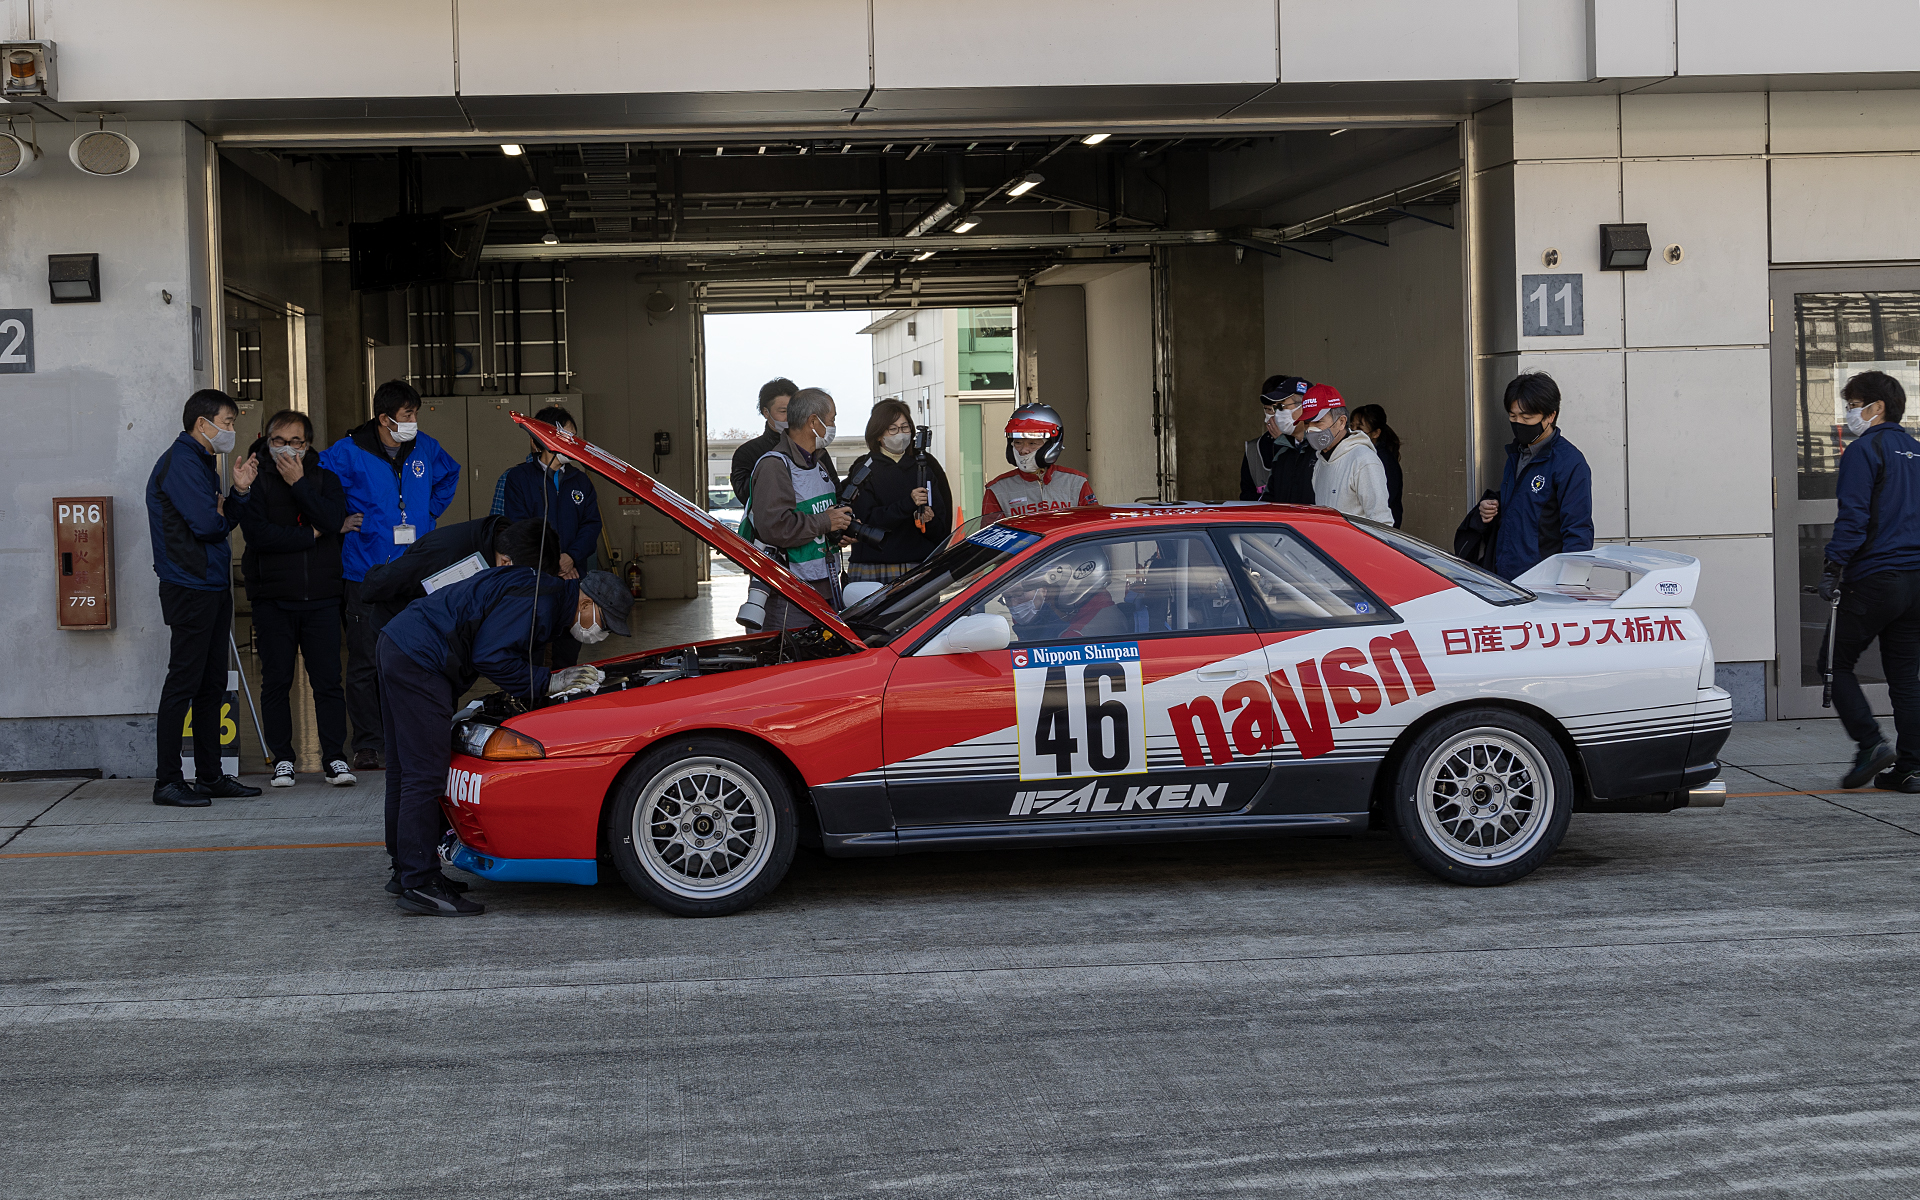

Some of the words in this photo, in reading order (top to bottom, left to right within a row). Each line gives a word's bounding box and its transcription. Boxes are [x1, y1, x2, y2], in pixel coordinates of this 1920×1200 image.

[1529, 281, 1574, 327] 11
[58, 504, 101, 524] PR6
[1010, 500, 1071, 516] NISSAN
[69, 596, 96, 607] 775
[1442, 615, 1686, 656] 日産プリンス栃木
[1033, 648, 1081, 665] Nippon
[1084, 644, 1139, 661] Shinpan
[1035, 662, 1131, 776] 46
[1008, 780, 1230, 816] FALKEN
[623, 835, 631, 844] FL
